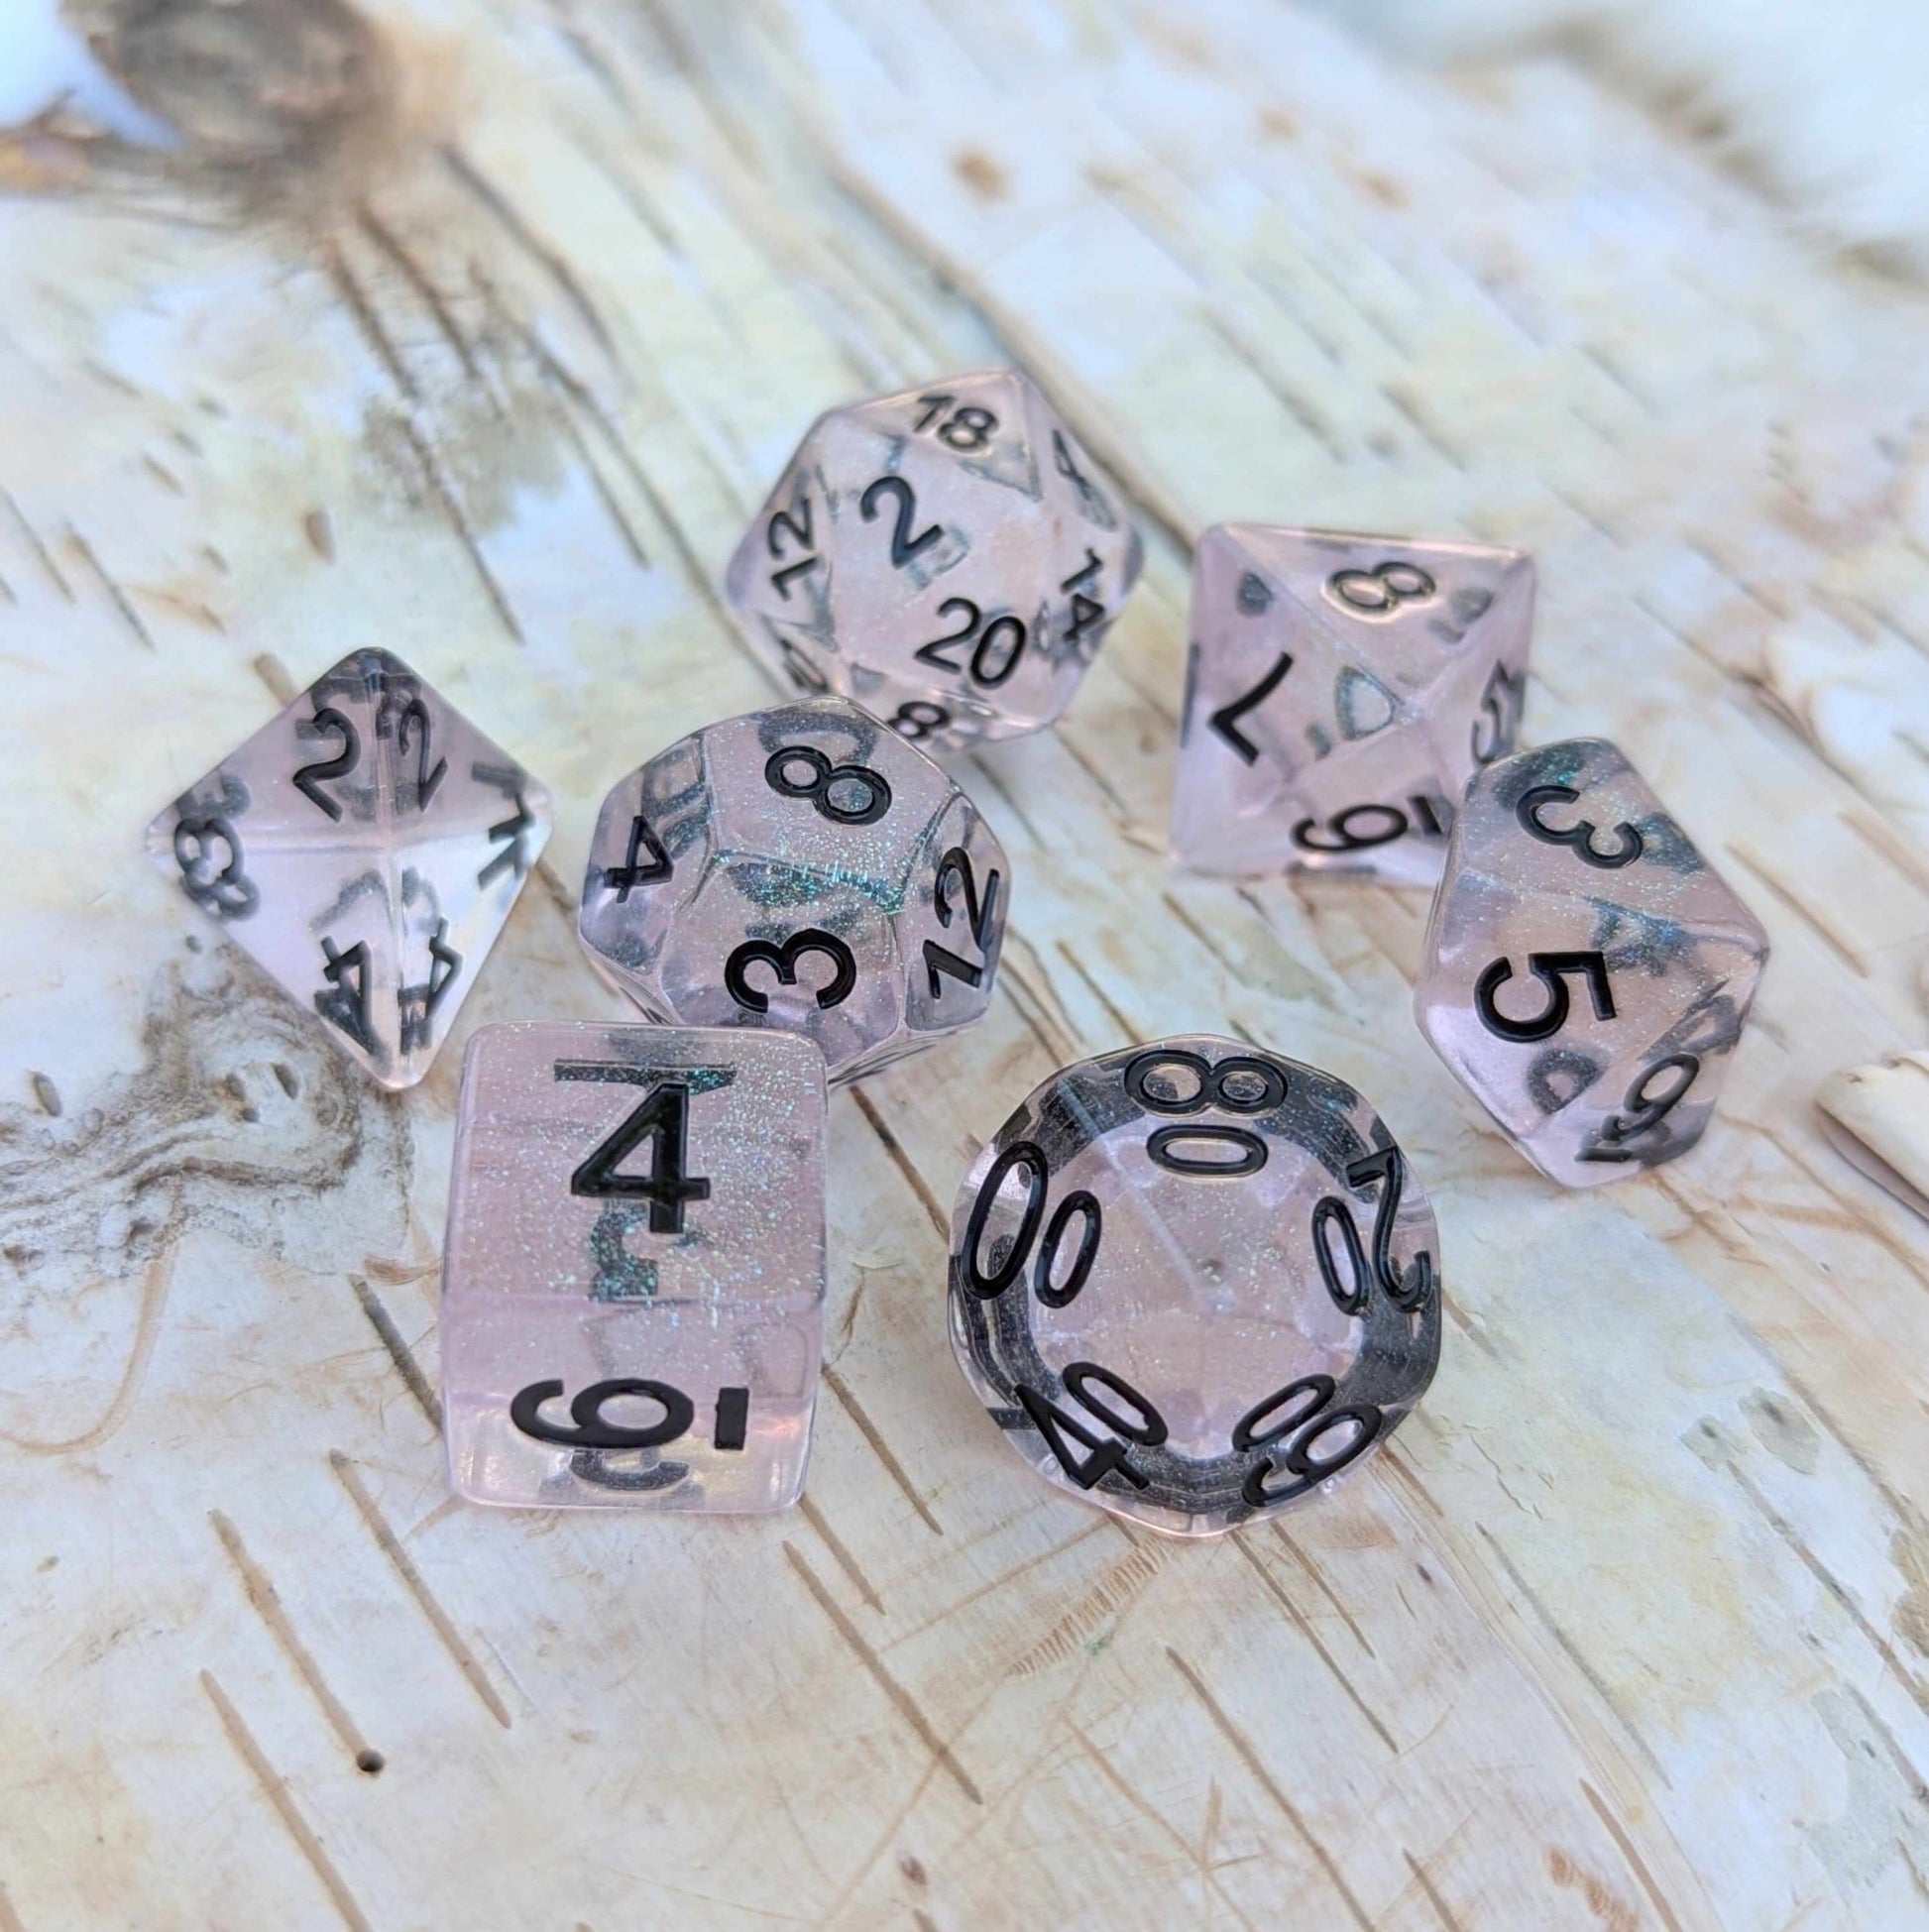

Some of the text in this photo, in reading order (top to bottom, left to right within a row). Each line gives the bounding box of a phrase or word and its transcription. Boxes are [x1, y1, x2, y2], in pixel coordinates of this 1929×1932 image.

[914, 395, 999, 451] 18
[767, 498, 820, 601] 12
[859, 475, 946, 569] 2
[1061, 547, 1105, 642] 14
[1328, 561, 1436, 613] 8
[915, 597, 1027, 689] 20
[399, 698, 449, 813] 2
[1207, 651, 1295, 767] 7
[292, 708, 362, 823] 2
[764, 745, 893, 826] 8
[604, 815, 674, 903] 4
[1515, 784, 1644, 869] 3
[923, 847, 1000, 999] 12
[725, 928, 856, 1013] 3
[1473, 951, 1617, 1043] 5
[571, 1082, 711, 1233] 4
